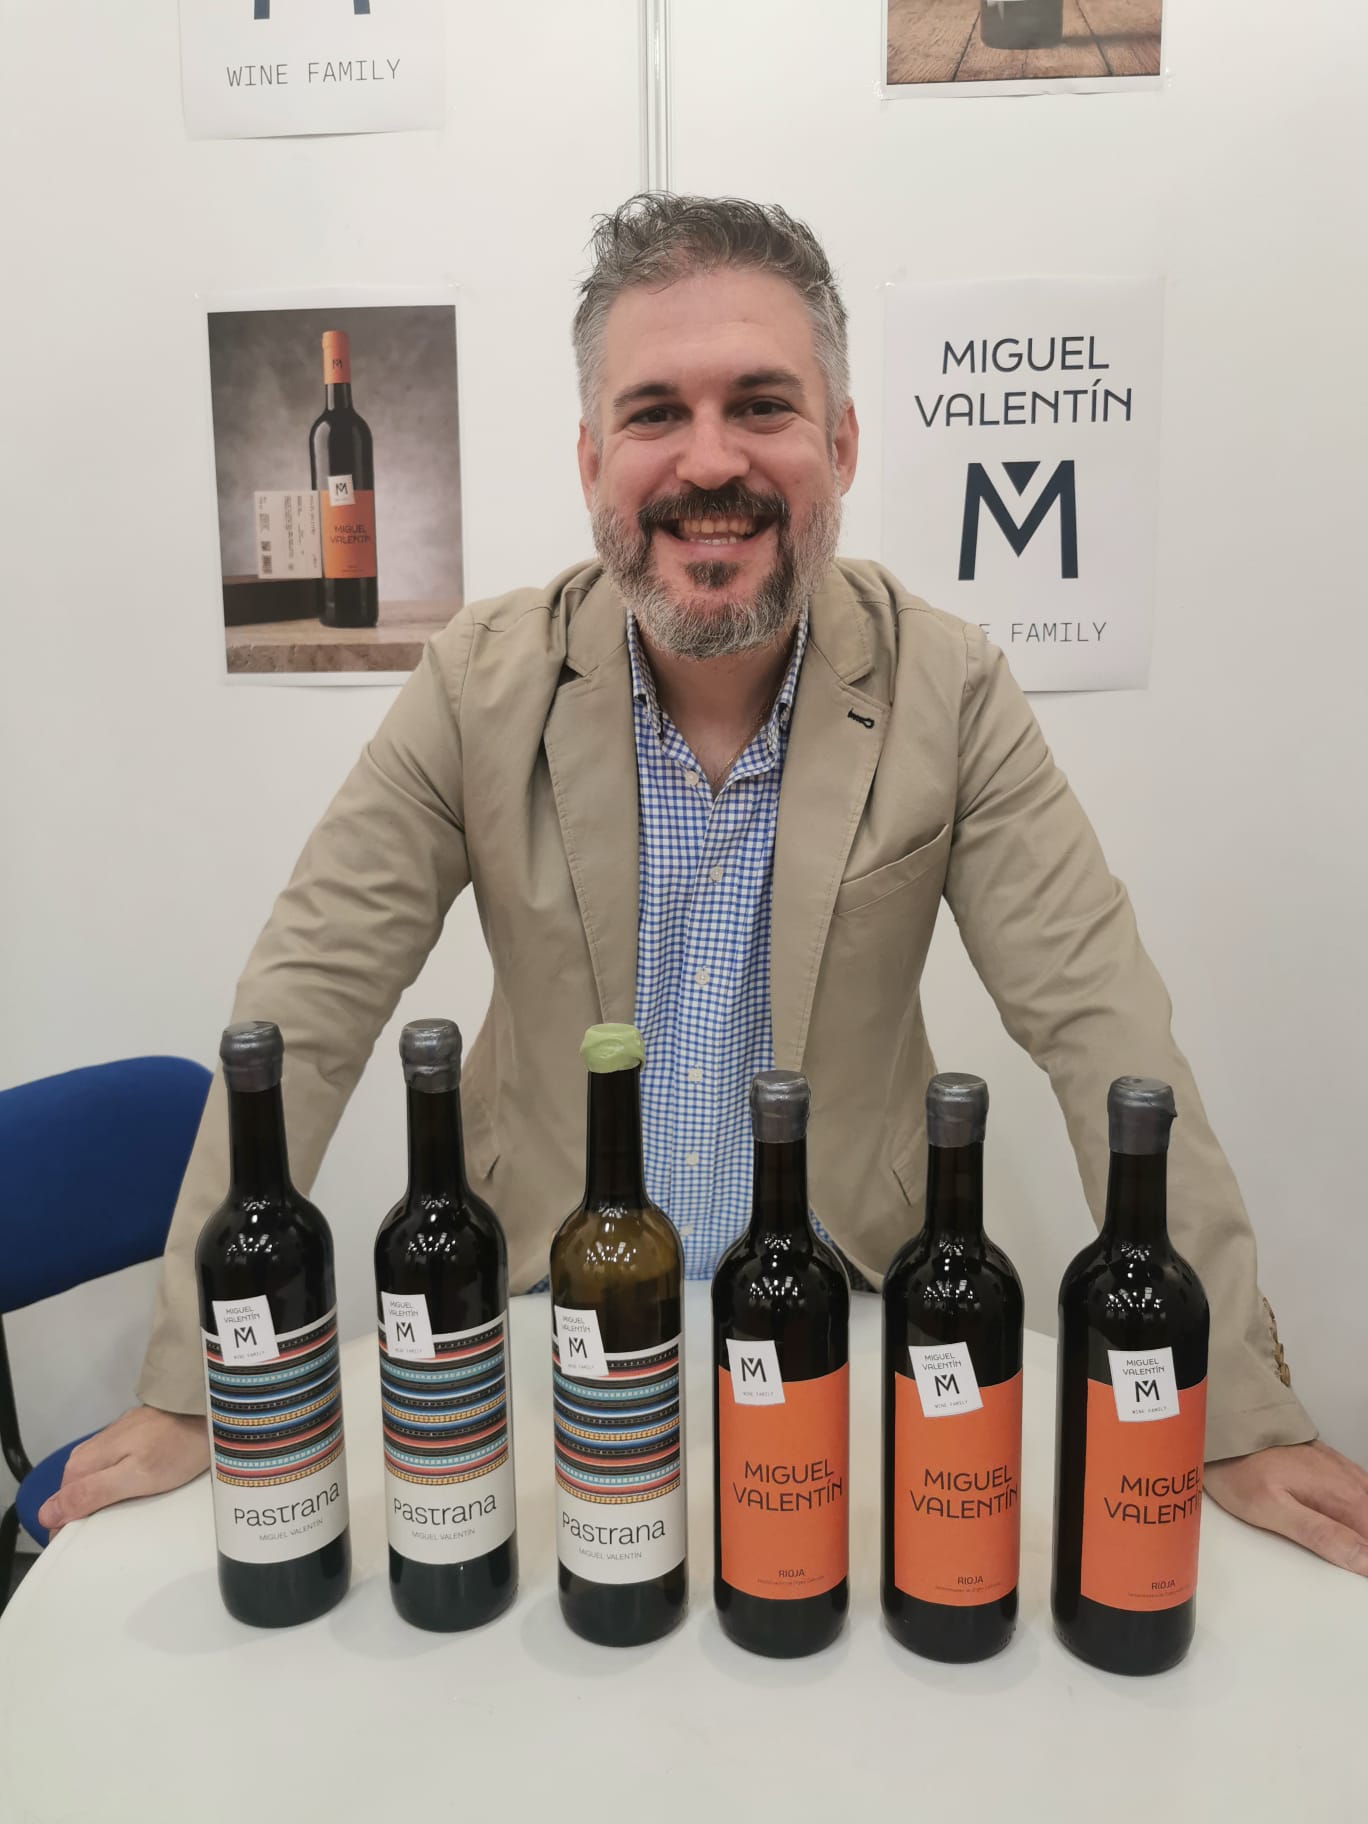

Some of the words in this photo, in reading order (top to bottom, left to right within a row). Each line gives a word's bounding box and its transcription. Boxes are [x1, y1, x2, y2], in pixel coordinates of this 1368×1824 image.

[226, 63, 290, 87] WINE
[308, 58, 401, 83] FAMILY
[942, 335, 1110, 375] MIGUEL
[914, 378, 1133, 428] VALENTÍN
[1010, 622, 1107, 643] FAMILY
[924, 1352, 956, 1361] MIGUEL
[1126, 1358, 1160, 1367] MIGUEL
[744, 1458, 834, 1485] MIGUEL
[924, 1464, 1013, 1492] MIGUEL
[1120, 1466, 1200, 1497] MIGUEL
[233, 1482, 340, 1527] Pastrana
[732, 1477, 843, 1512] VALENTÍN
[910, 1483, 1018, 1519] VALENTÍN
[393, 1494, 497, 1526] Pastrana
[562, 1511, 666, 1545] Pastrana
[778, 1568, 805, 1578] RIOJA
[957, 1575, 984, 1585] RIOJA
[1151, 1579, 1176, 1590] RIOJA
